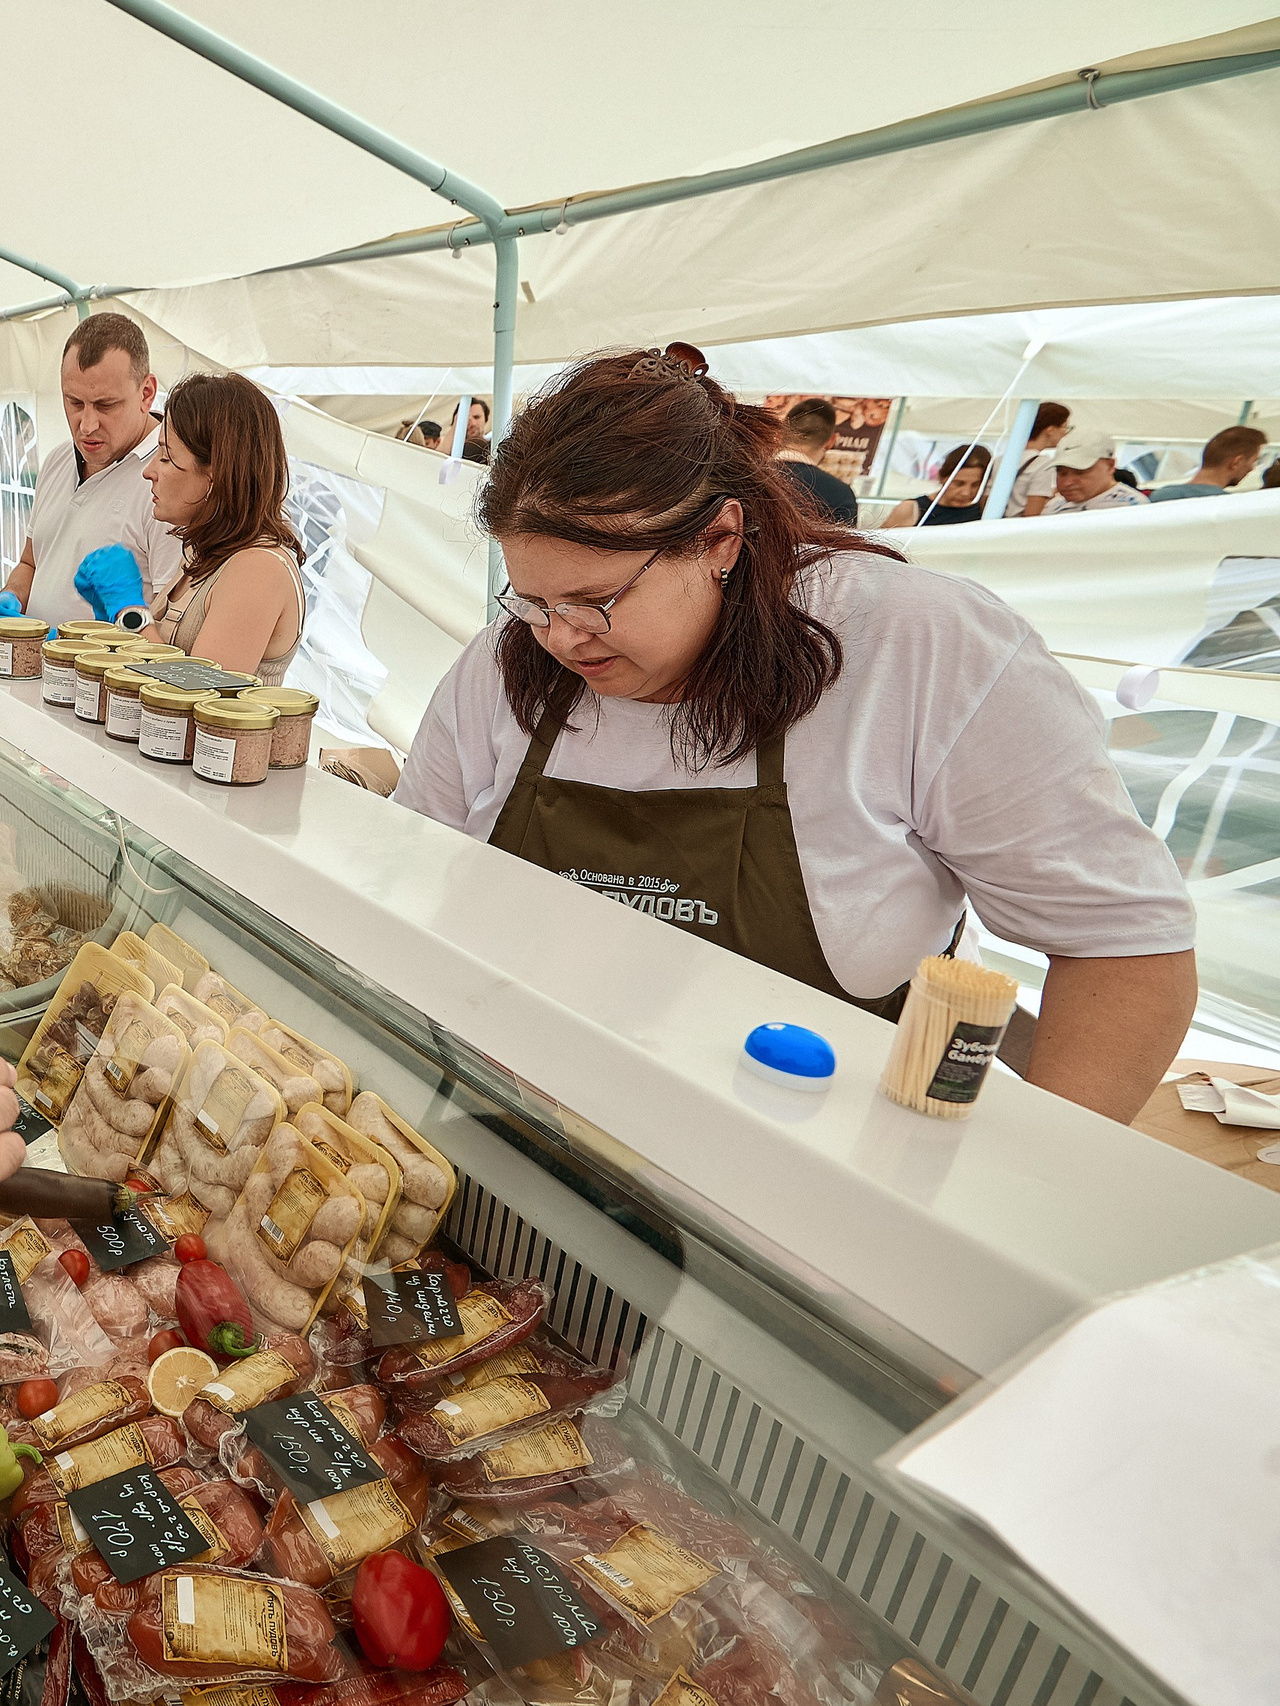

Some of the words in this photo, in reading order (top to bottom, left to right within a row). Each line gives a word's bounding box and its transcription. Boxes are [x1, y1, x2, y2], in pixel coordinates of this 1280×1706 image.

[580, 869, 625, 885] Основана
[628, 877, 634, 885] в
[638, 876, 660, 889] 2015
[97, 1225, 125, 1256] 500р
[336, 1408, 350, 1427] ПЯТЬ
[348, 1427, 362, 1444] ПУД
[559, 1424, 580, 1455] ПУДОВЪ
[382, 1490, 406, 1520] ПУДОВЪ
[267, 1595, 275, 1619] ПЯТЬ
[270, 1622, 280, 1657] ПУДОВЪ
